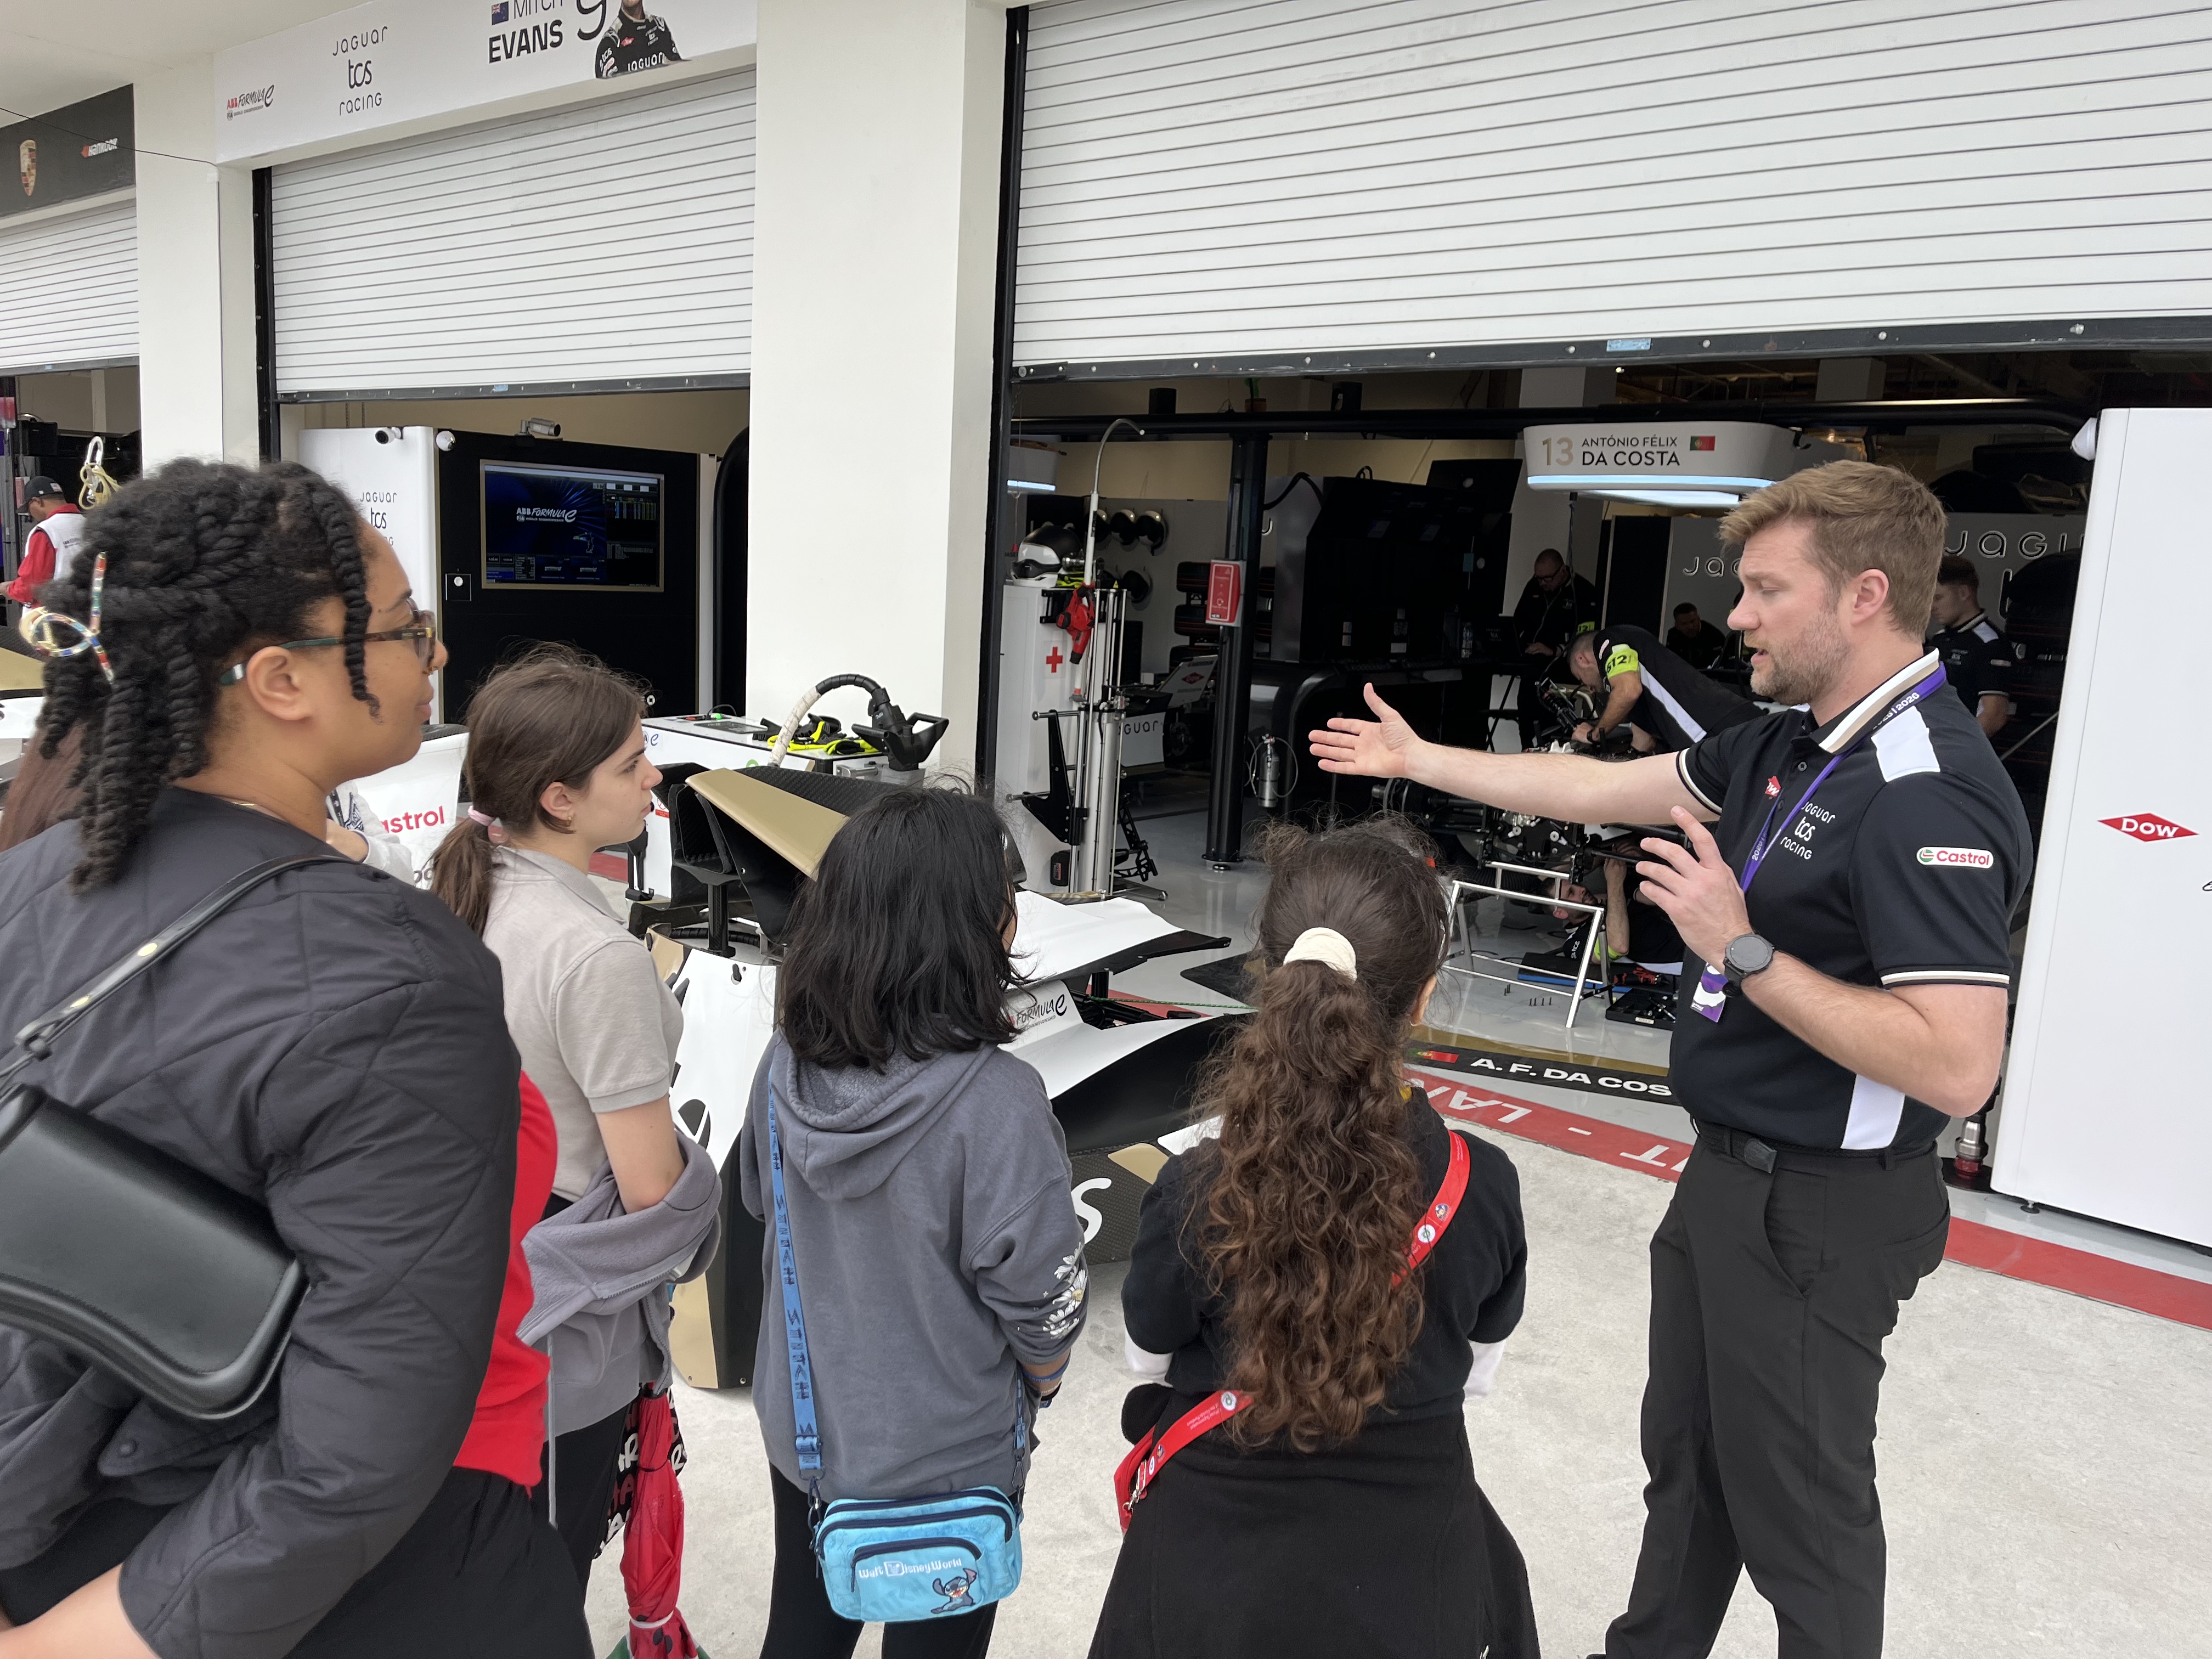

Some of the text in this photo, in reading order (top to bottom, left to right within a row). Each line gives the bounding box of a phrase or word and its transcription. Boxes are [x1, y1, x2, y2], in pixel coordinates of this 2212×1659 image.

[489, 19, 563, 64] EVANS
[1542, 437, 1574, 466] 13
[1582, 434, 1678, 448] ANTÓNIO FÉLIX
[1582, 450, 1680, 466] DA COSTA
[531, 507, 566, 518] FORMULA
[380, 805, 444, 833] strol
[2121, 817, 2180, 838] DOW
[1936, 850, 1990, 866] Castrol
[1016, 999, 1055, 1026] FORMULA
[1471, 1058, 1503, 1071] A.
[1509, 1063, 1537, 1076] F.
[1543, 1068, 1592, 1085] DA
[787, 1308, 810, 1401] STITCH
[859, 1565, 885, 1578] Walt
[931, 1558, 962, 1571] World
